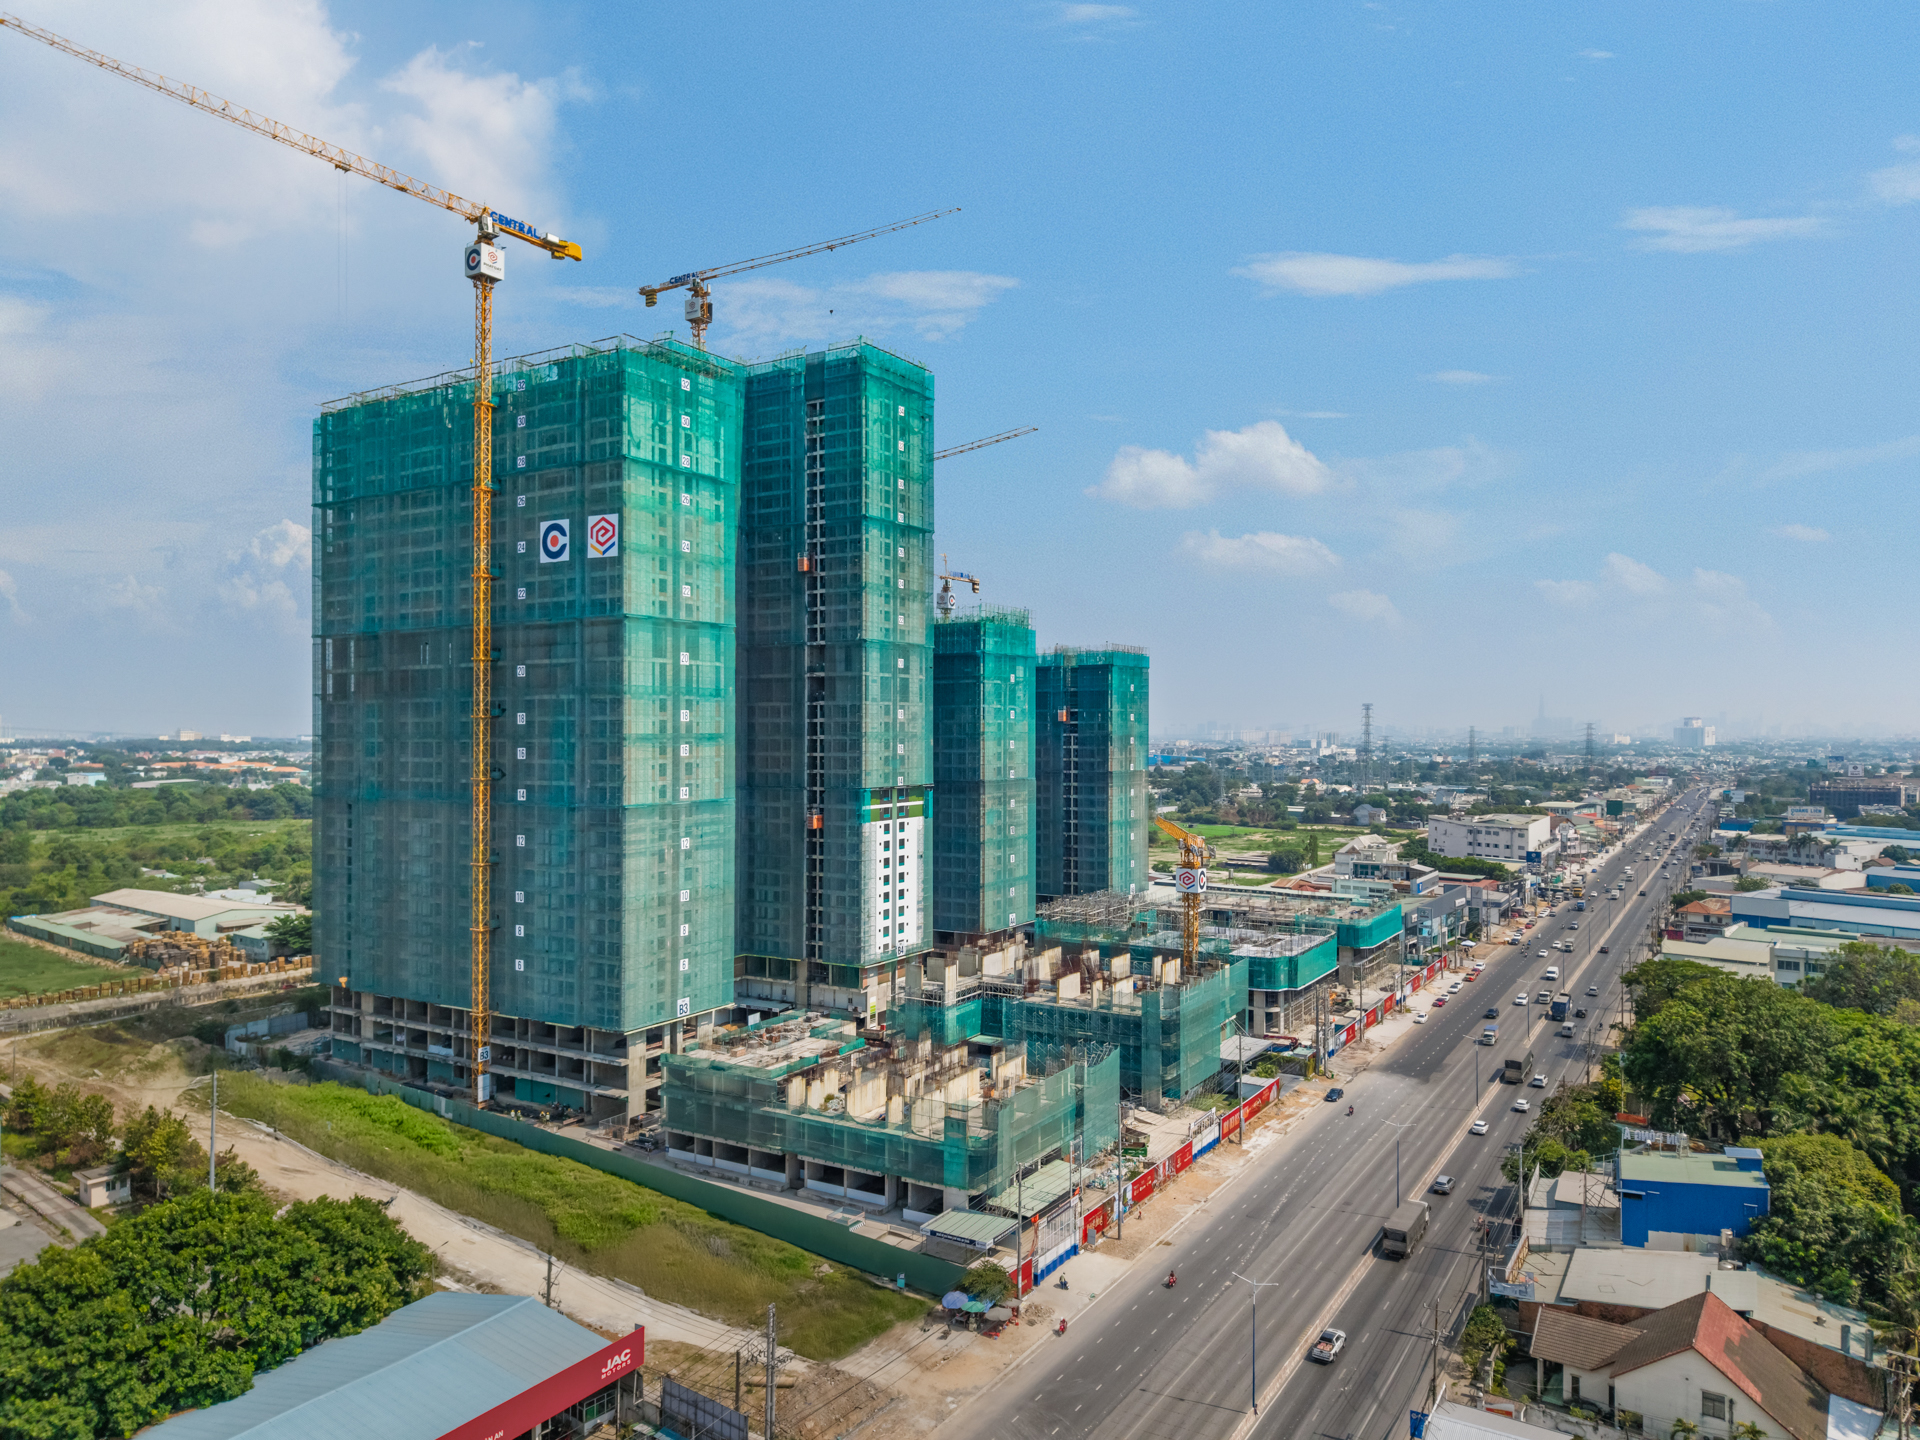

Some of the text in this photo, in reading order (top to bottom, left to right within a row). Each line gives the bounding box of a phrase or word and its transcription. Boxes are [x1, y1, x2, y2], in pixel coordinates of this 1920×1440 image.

[490, 211, 540, 239] CENTRAL
[670, 271, 700, 284] CENTRAL
[518, 381, 525, 390] 32
[682, 380, 690, 390] 32
[518, 417, 525, 426] 30
[682, 418, 690, 426] 30
[518, 457, 525, 466] 28
[682, 457, 690, 466] 28
[518, 496, 525, 506] 26
[682, 495, 690, 505] 26
[518, 542, 525, 552] 24
[682, 542, 690, 551] 24
[518, 589, 525, 598] 22
[683, 587, 690, 596] 22
[681, 654, 689, 663] 20
[518, 667, 525, 675] 20
[518, 714, 525, 723] 18
[681, 712, 689, 720] 18
[681, 746, 689, 755] 16
[518, 790, 526, 799] 14
[681, 788, 688, 797] 14
[517, 836, 525, 845] 12
[681, 838, 689, 848] 12
[516, 892, 524, 901] 10
[681, 891, 688, 900] 10
[898, 946, 904, 955] B4
[679, 1003, 688, 1015] B3
[480, 1050, 489, 1060] B3
[602, 1348, 631, 1373] JAC
[601, 1360, 631, 1380] MOTORS
